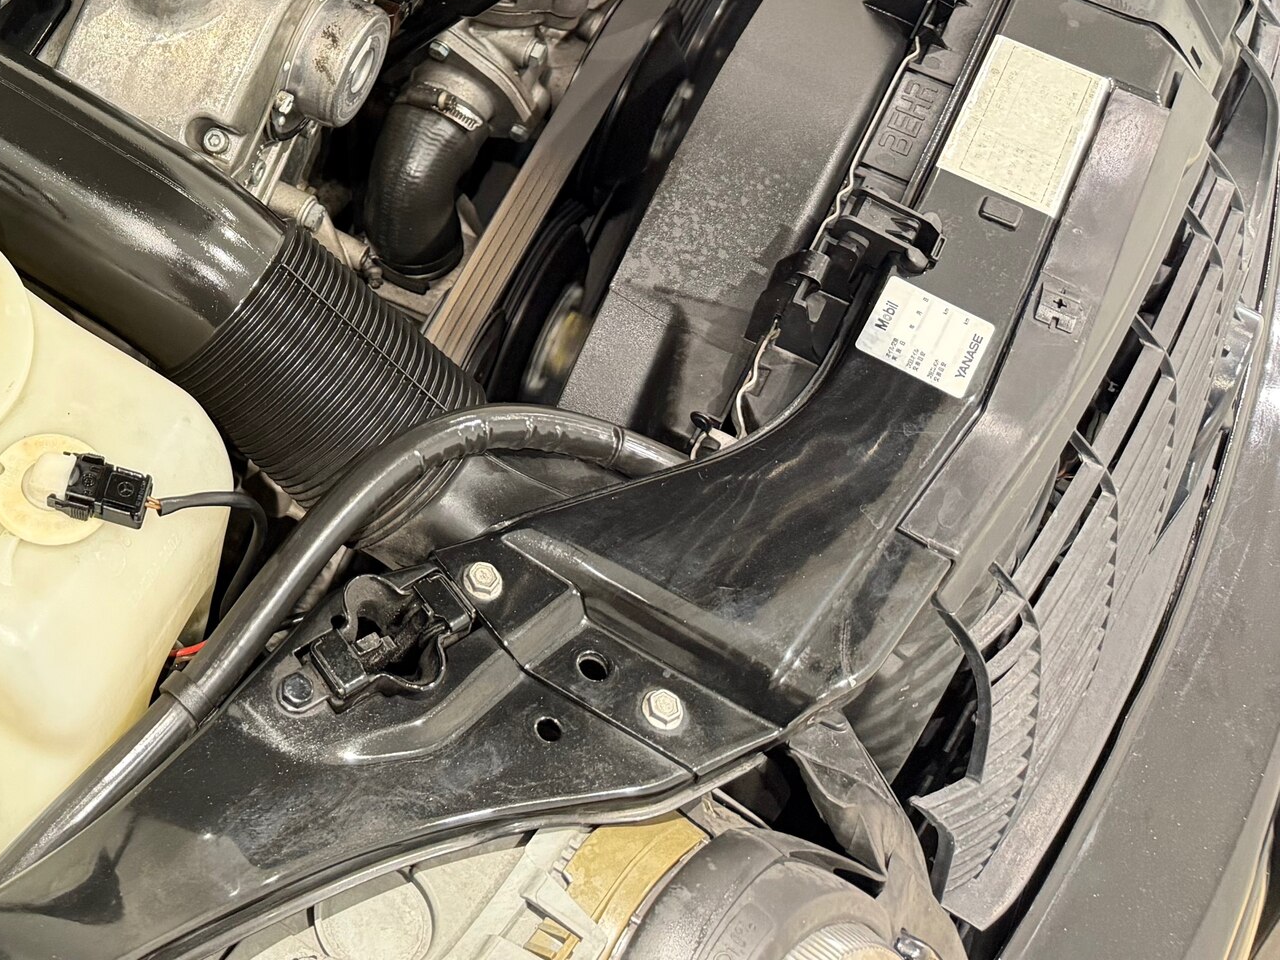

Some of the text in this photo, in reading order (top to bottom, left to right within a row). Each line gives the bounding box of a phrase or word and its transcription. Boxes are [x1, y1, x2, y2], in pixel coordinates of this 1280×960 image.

[878, 78, 939, 157] BEHR
[874, 300, 899, 331] Mobil
[954, 333, 984, 379] YANASE
